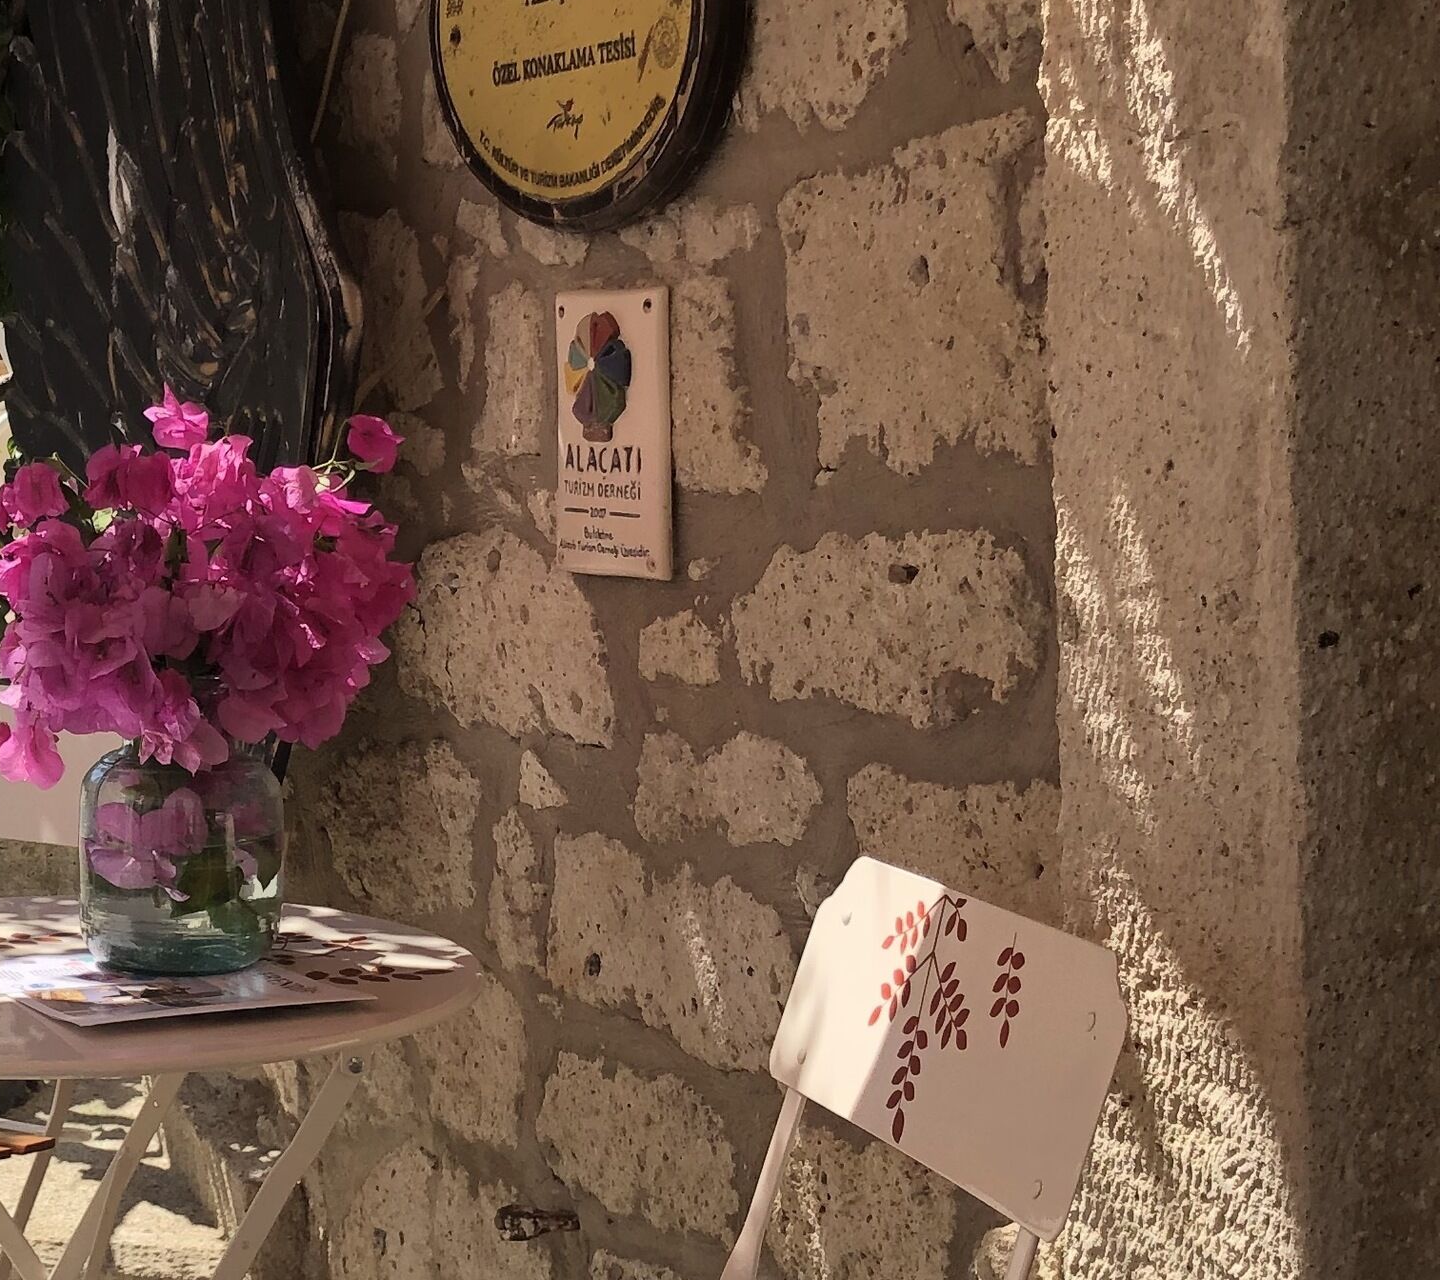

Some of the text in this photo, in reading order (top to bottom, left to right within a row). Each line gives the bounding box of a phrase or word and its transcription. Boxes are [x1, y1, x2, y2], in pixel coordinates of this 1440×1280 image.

[491, 29, 637, 87] ÖZEL KONAKLAMA TESİSİ
[519, 165, 530, 182] VE
[558, 160, 600, 188] BAKANLIĞI
[565, 443, 642, 480] ALAÇATI
[564, 477, 641, 501] TURİZM DERNEĞİ
